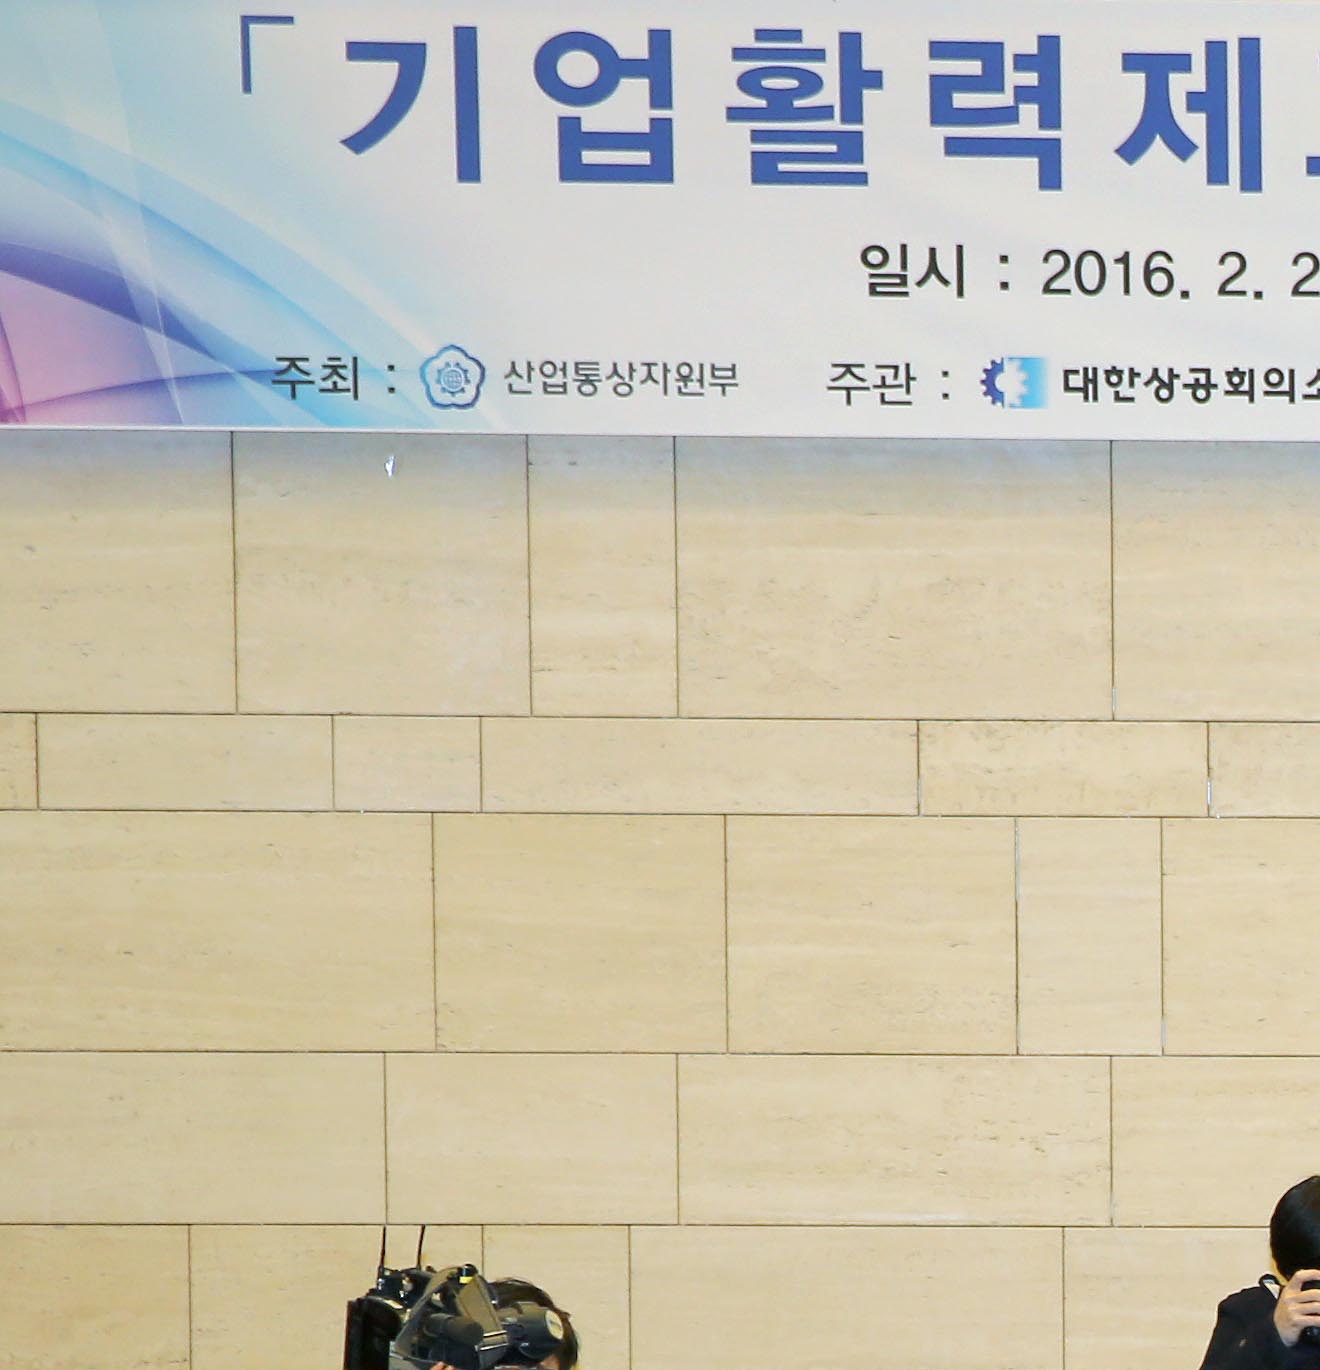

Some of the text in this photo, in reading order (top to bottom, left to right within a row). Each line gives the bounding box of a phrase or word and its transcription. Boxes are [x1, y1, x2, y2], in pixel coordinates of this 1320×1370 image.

[861, 244, 966, 300] 일시
[1000, 256, 1010, 292] :
[1043, 250, 1191, 301] 2016.
[1218, 252, 1265, 301] 2.
[271, 357, 397, 402] 주최 :
[504, 361, 741, 399] 산업통상자원부
[826, 362, 951, 408] 주관 :
